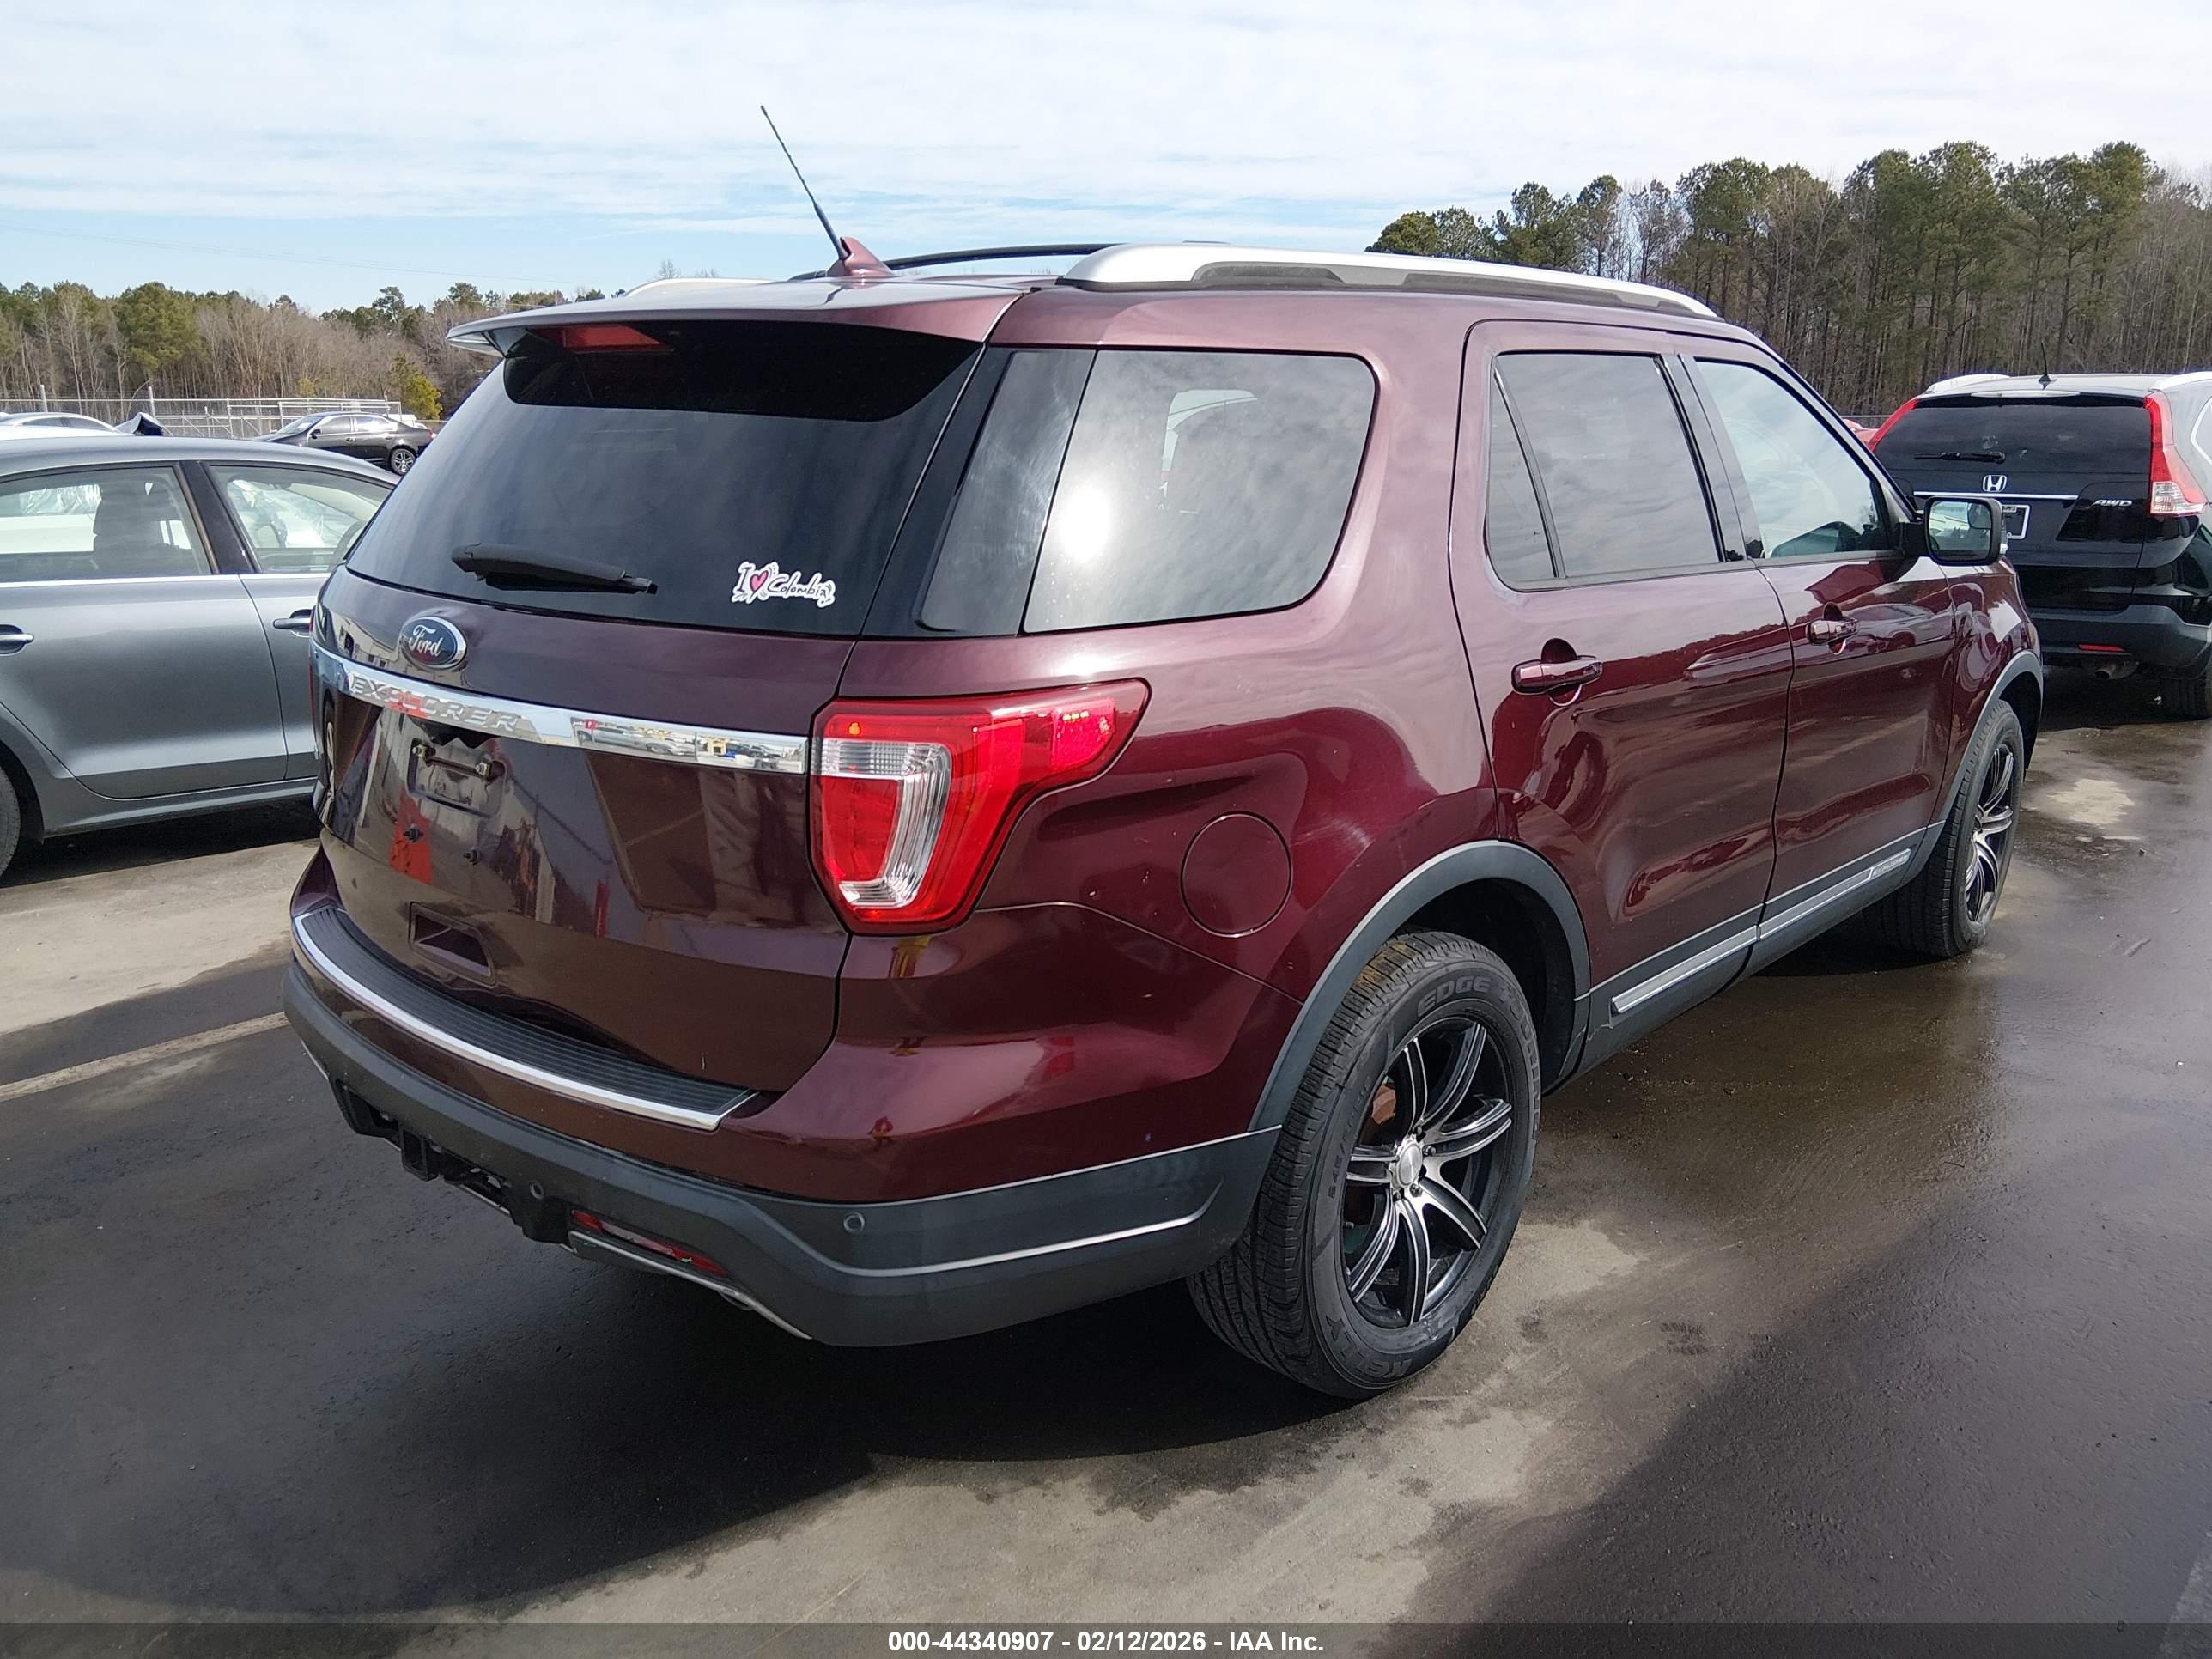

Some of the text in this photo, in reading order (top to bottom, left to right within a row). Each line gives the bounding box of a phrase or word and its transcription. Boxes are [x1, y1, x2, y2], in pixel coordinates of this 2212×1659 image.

[767, 573, 828, 599] Colombia
[408, 624, 442, 658] Ford
[348, 673, 520, 732] EXPLORER
[1417, 975, 1492, 1018] EDGE
